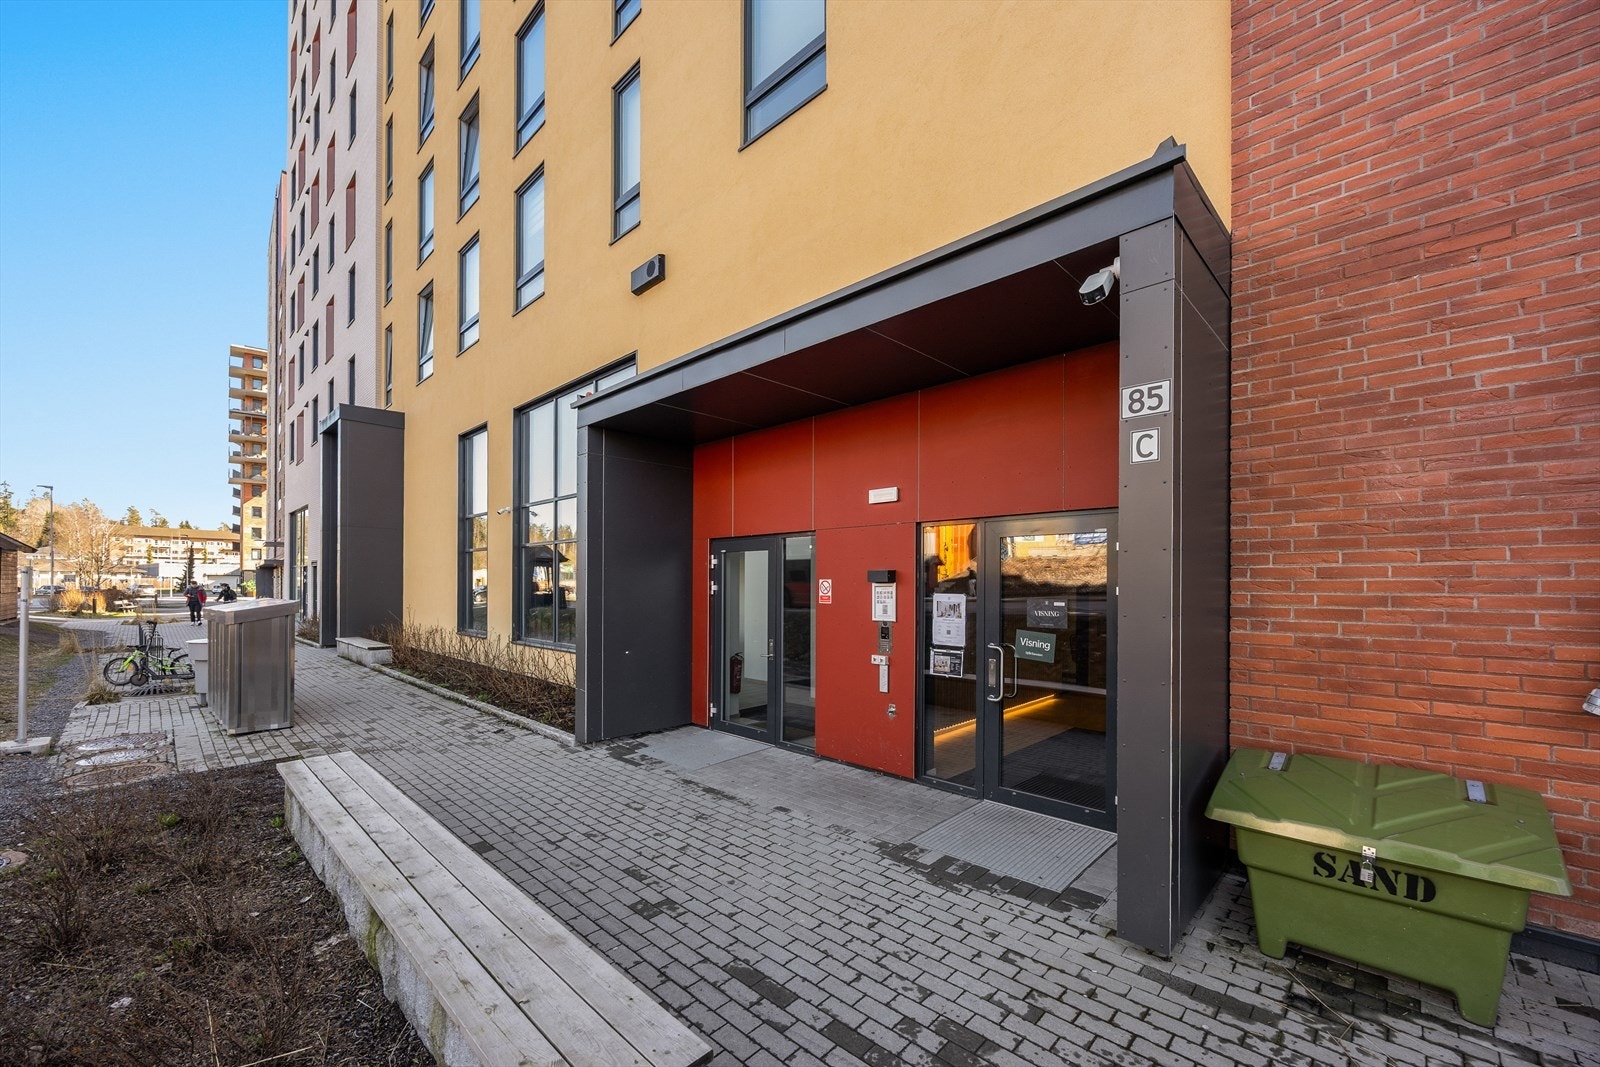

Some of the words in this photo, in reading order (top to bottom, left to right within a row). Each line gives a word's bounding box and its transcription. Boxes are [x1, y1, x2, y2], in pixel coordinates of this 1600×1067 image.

[1128, 384, 1164, 414] 85
[1136, 433, 1154, 458] C
[1020, 637, 1051, 651] Visning
[1313, 851, 1437, 903] SAND
